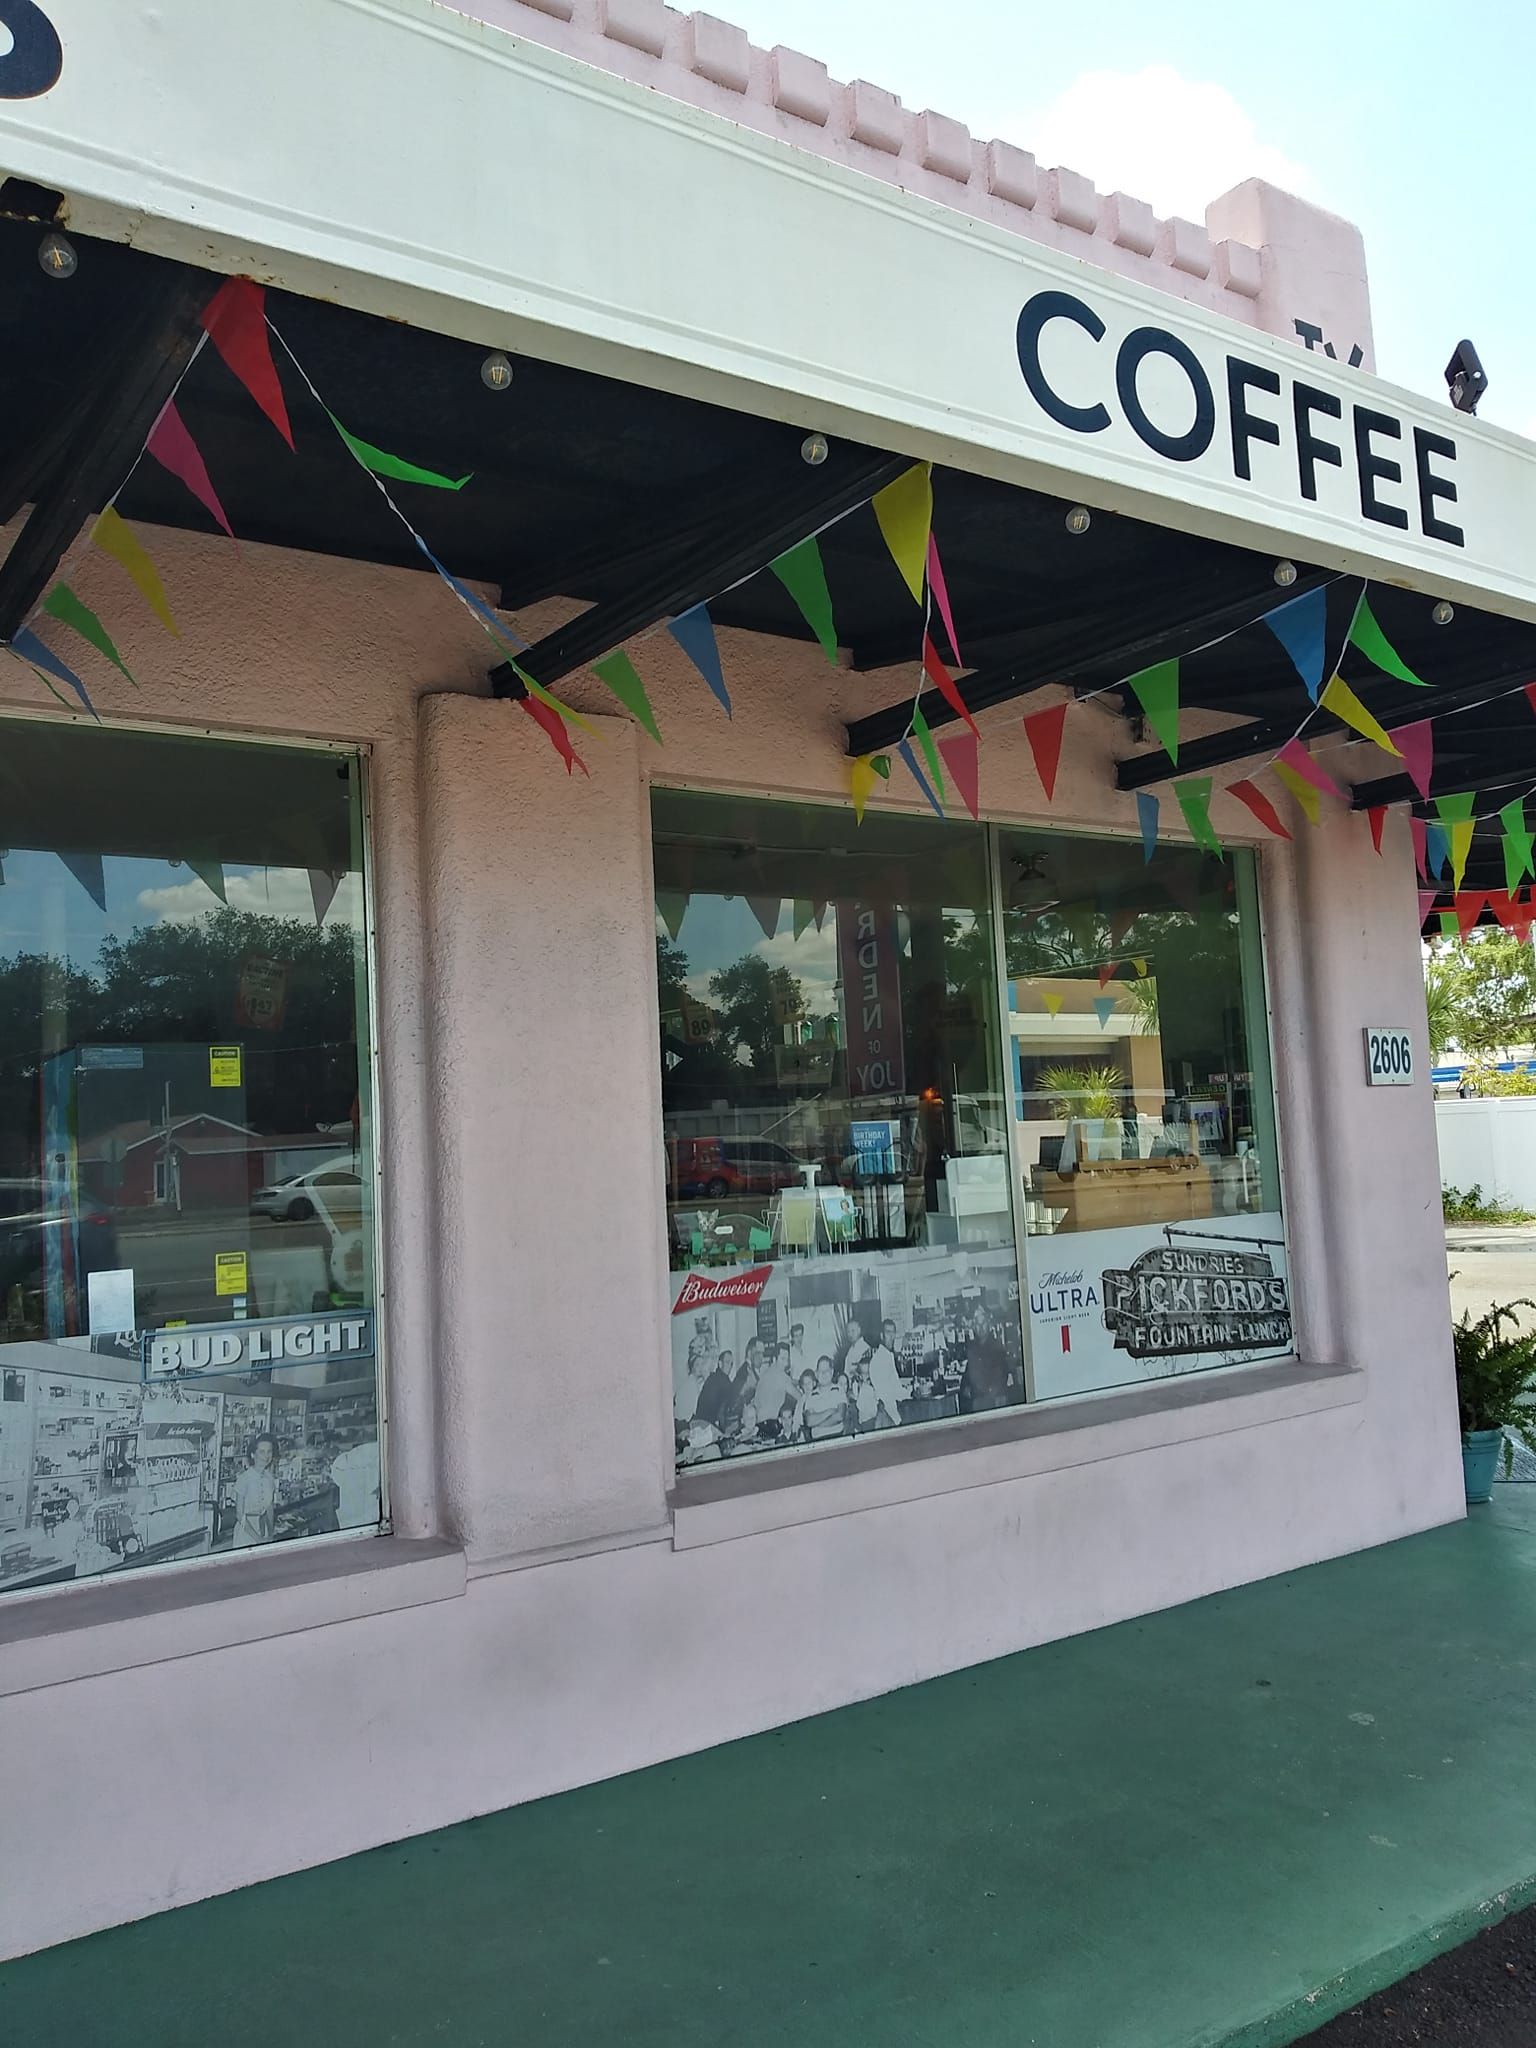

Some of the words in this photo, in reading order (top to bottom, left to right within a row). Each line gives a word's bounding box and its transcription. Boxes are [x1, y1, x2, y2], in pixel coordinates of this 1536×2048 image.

[1016, 289, 1465, 548] COFFEE
[691, 1019, 710, 1036] 89
[1370, 1035, 1412, 1074] 2606
[853, 1130, 885, 1140] BIRTHDAY
[1161, 1251, 1245, 1273] SUNDRIES
[682, 1279, 764, 1304] Budweiser
[1038, 1269, 1083, 1289] Michelob
[1030, 1286, 1098, 1314] ULTRA
[1115, 1274, 1287, 1312] PICKFORD'S
[151, 1333, 243, 1373] BUD
[249, 1319, 366, 1362] LIGHT
